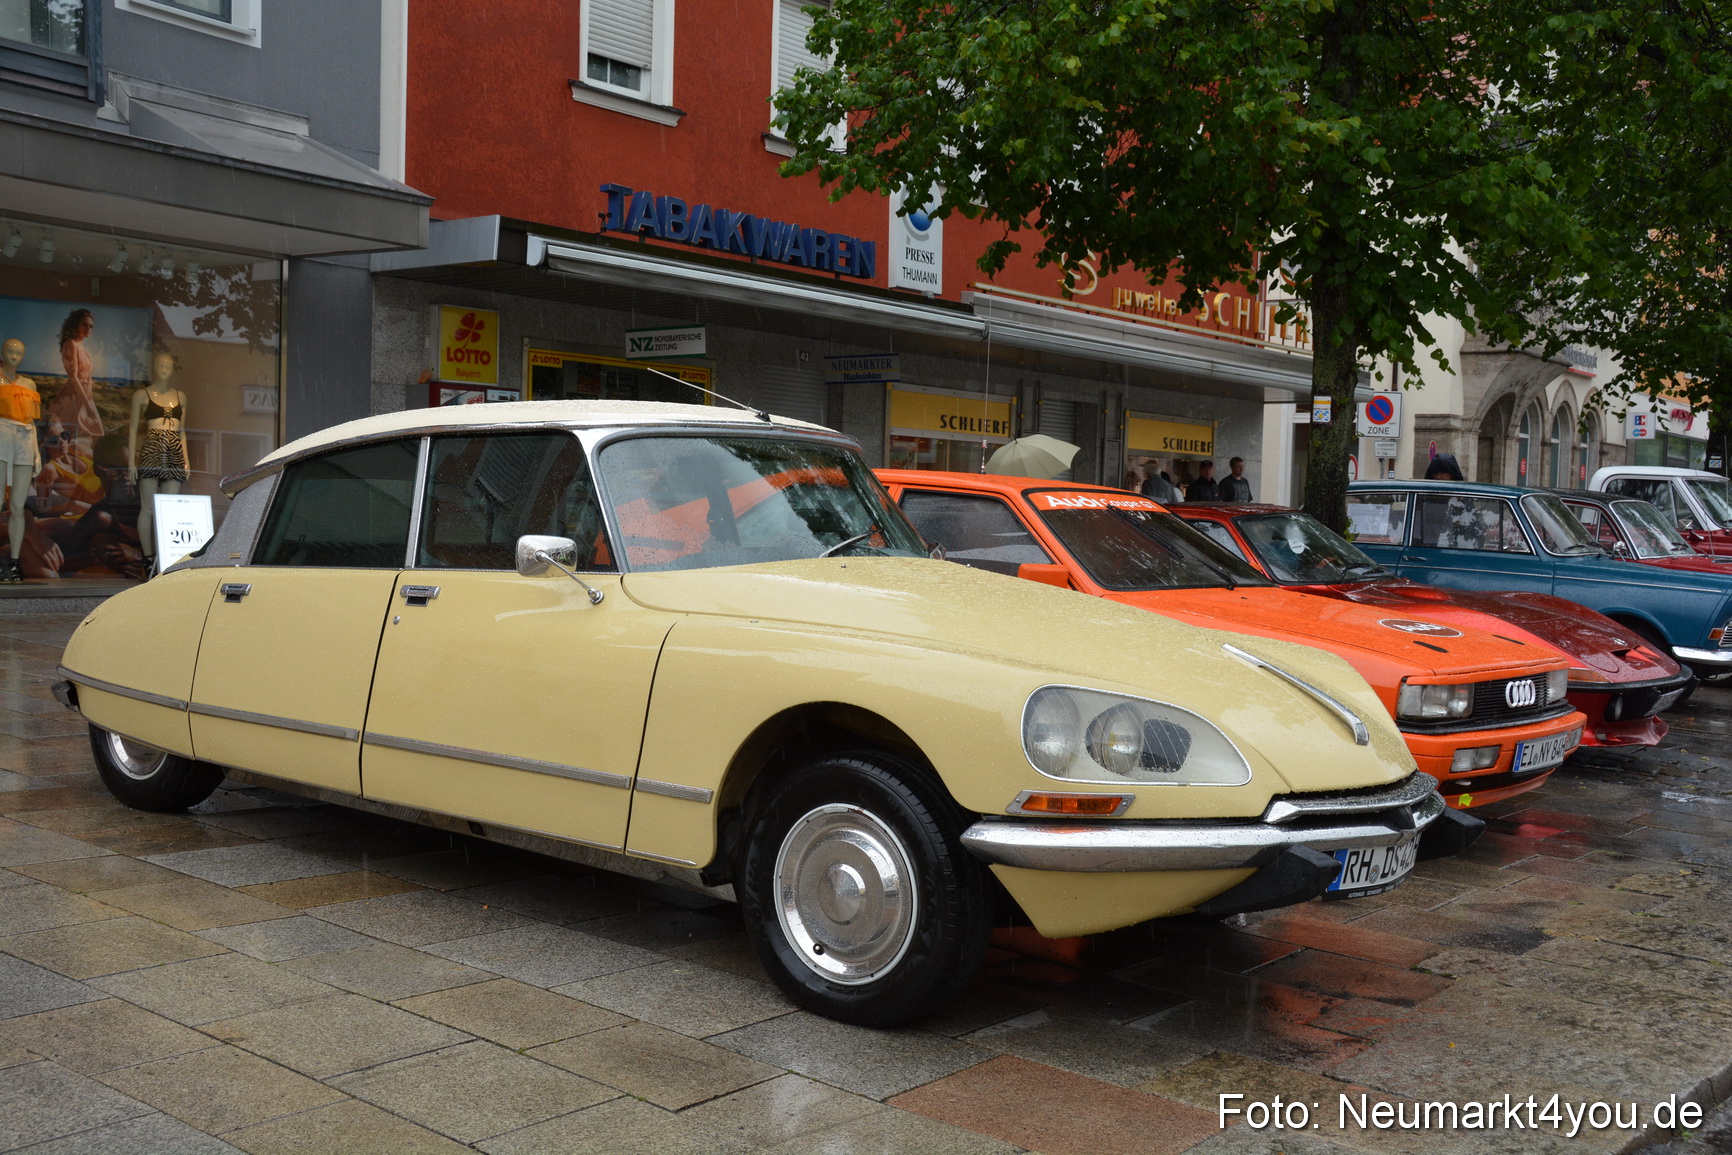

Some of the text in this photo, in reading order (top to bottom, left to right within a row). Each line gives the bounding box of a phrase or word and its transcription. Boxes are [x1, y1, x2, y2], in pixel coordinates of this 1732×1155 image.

[600, 183, 876, 279] TABAKWAREN
[905, 247, 935, 265] PRESSE
[902, 266, 938, 285] THUMANN
[1112, 287, 1312, 344] juwelie SCHLIER
[629, 336, 654, 352] NZ
[654, 333, 702, 344] NORDBAYERISCHE
[654, 343, 678, 351] ZEITUNG
[446, 347, 492, 366] LOTTO
[540, 356, 561, 365] LOTTO
[801, 352, 810, 361] 41
[831, 358, 893, 371] NEUMARKTER
[456, 368, 481, 378] Bayern
[688, 373, 706, 381] LOTTO
[842, 372, 882, 381] Nachrichten
[940, 414, 1009, 434] SCHLIERF
[1367, 427, 1389, 435] ZONE
[1163, 437, 1212, 453] SCHLIERF
[170, 529, 203, 545] 20%
[1521, 744, 1535, 767] EI
[1538, 741, 1553, 763] NY
[1343, 849, 1374, 883] RH
